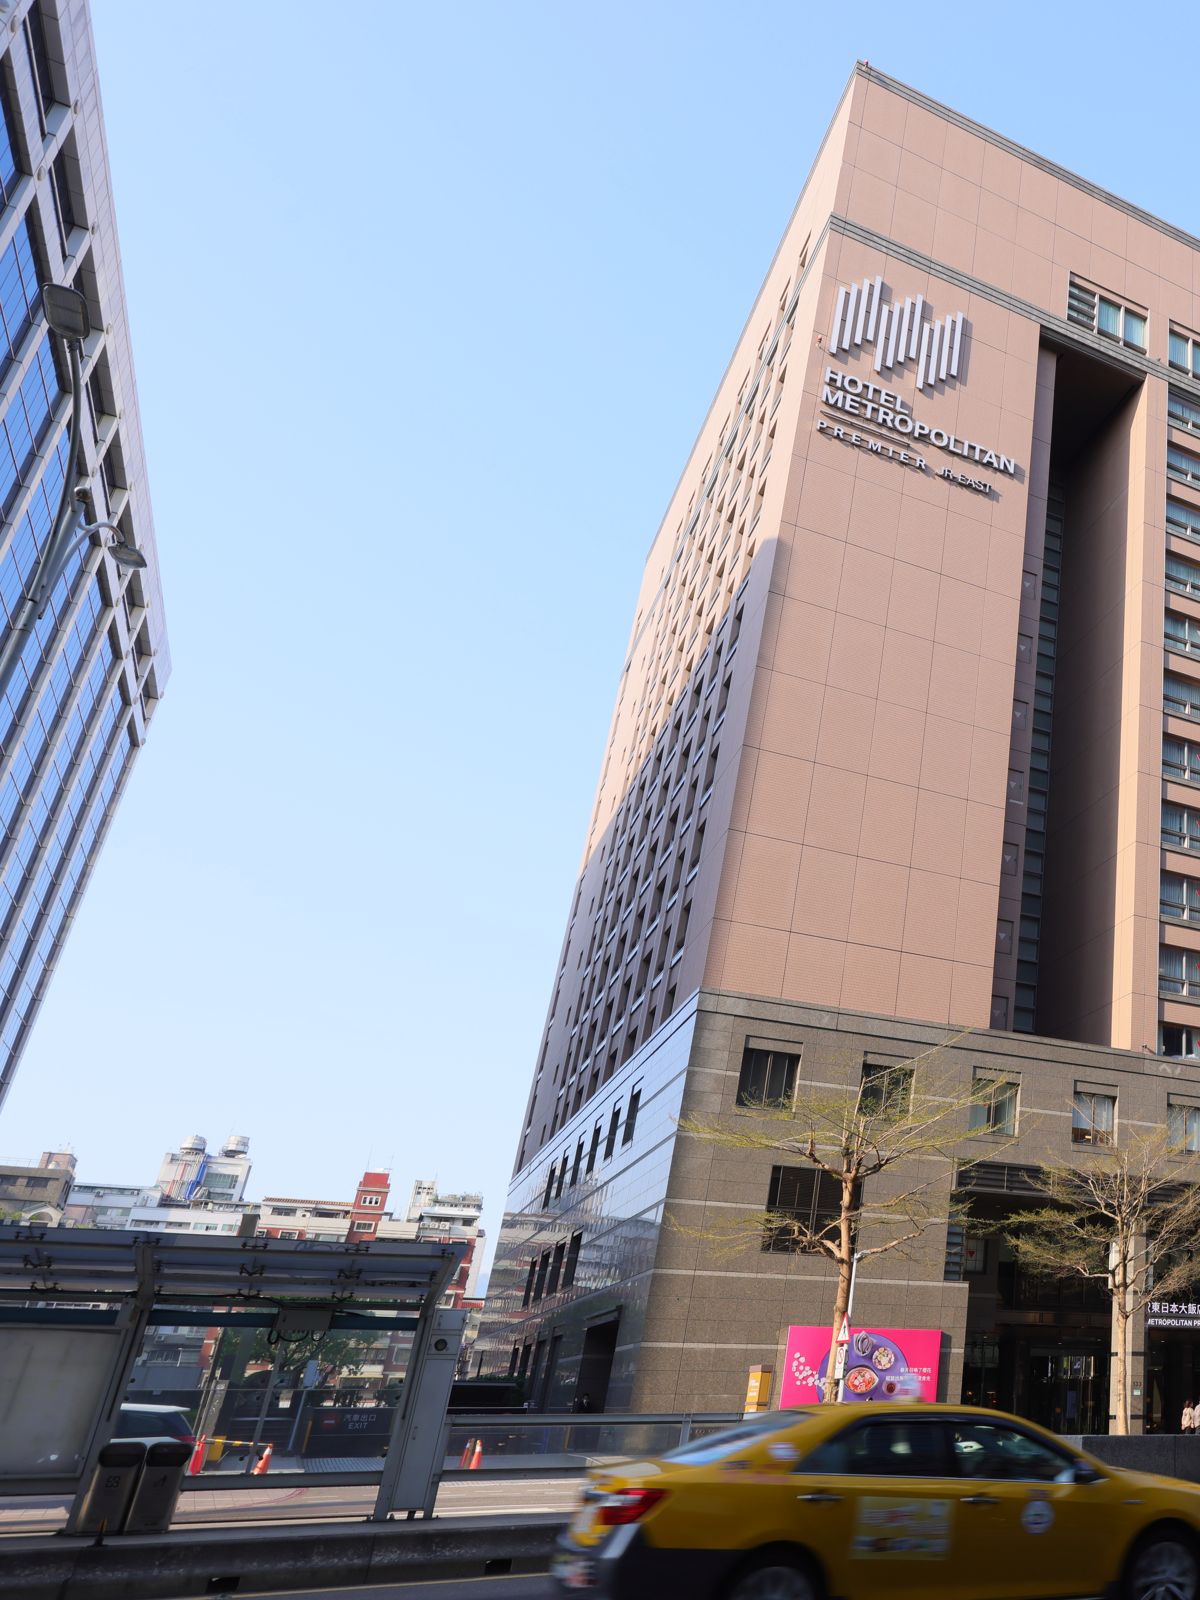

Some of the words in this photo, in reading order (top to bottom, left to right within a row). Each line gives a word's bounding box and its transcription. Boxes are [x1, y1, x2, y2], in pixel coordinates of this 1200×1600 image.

[824, 366, 909, 414] HOTEL
[816, 419, 926, 469] PREMIER
[821, 384, 1016, 474] METROPOLITAN
[348, 1422, 368, 1430] EXIT
